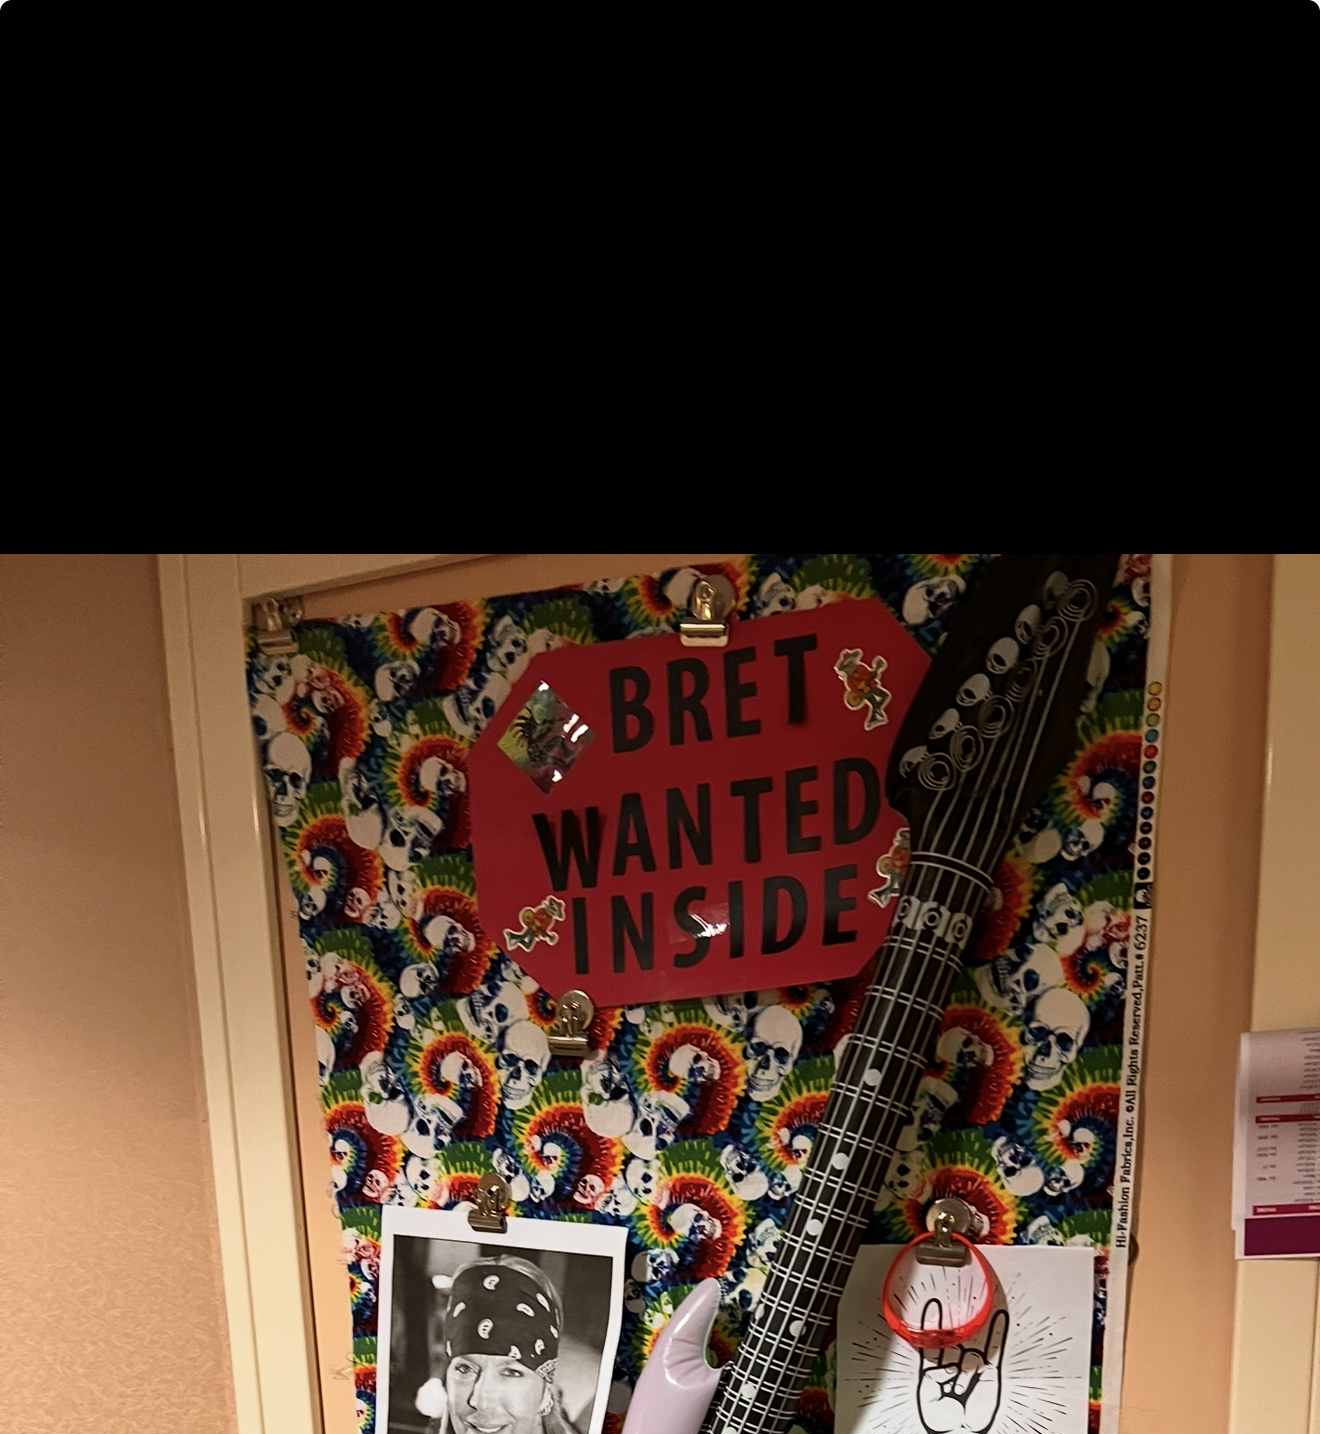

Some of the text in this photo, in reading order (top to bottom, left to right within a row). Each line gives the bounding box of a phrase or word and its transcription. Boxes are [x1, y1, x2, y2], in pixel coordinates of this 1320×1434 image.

[609, 633, 817, 753] BRET
[532, 757, 881, 892] WANTED
[573, 865, 858, 975] INSIDE
[1115, 1187, 1130, 1248] Hi-Fashion
[1126, 1049, 1140, 1086] Rights
[1134, 916, 1148, 951] 6237
